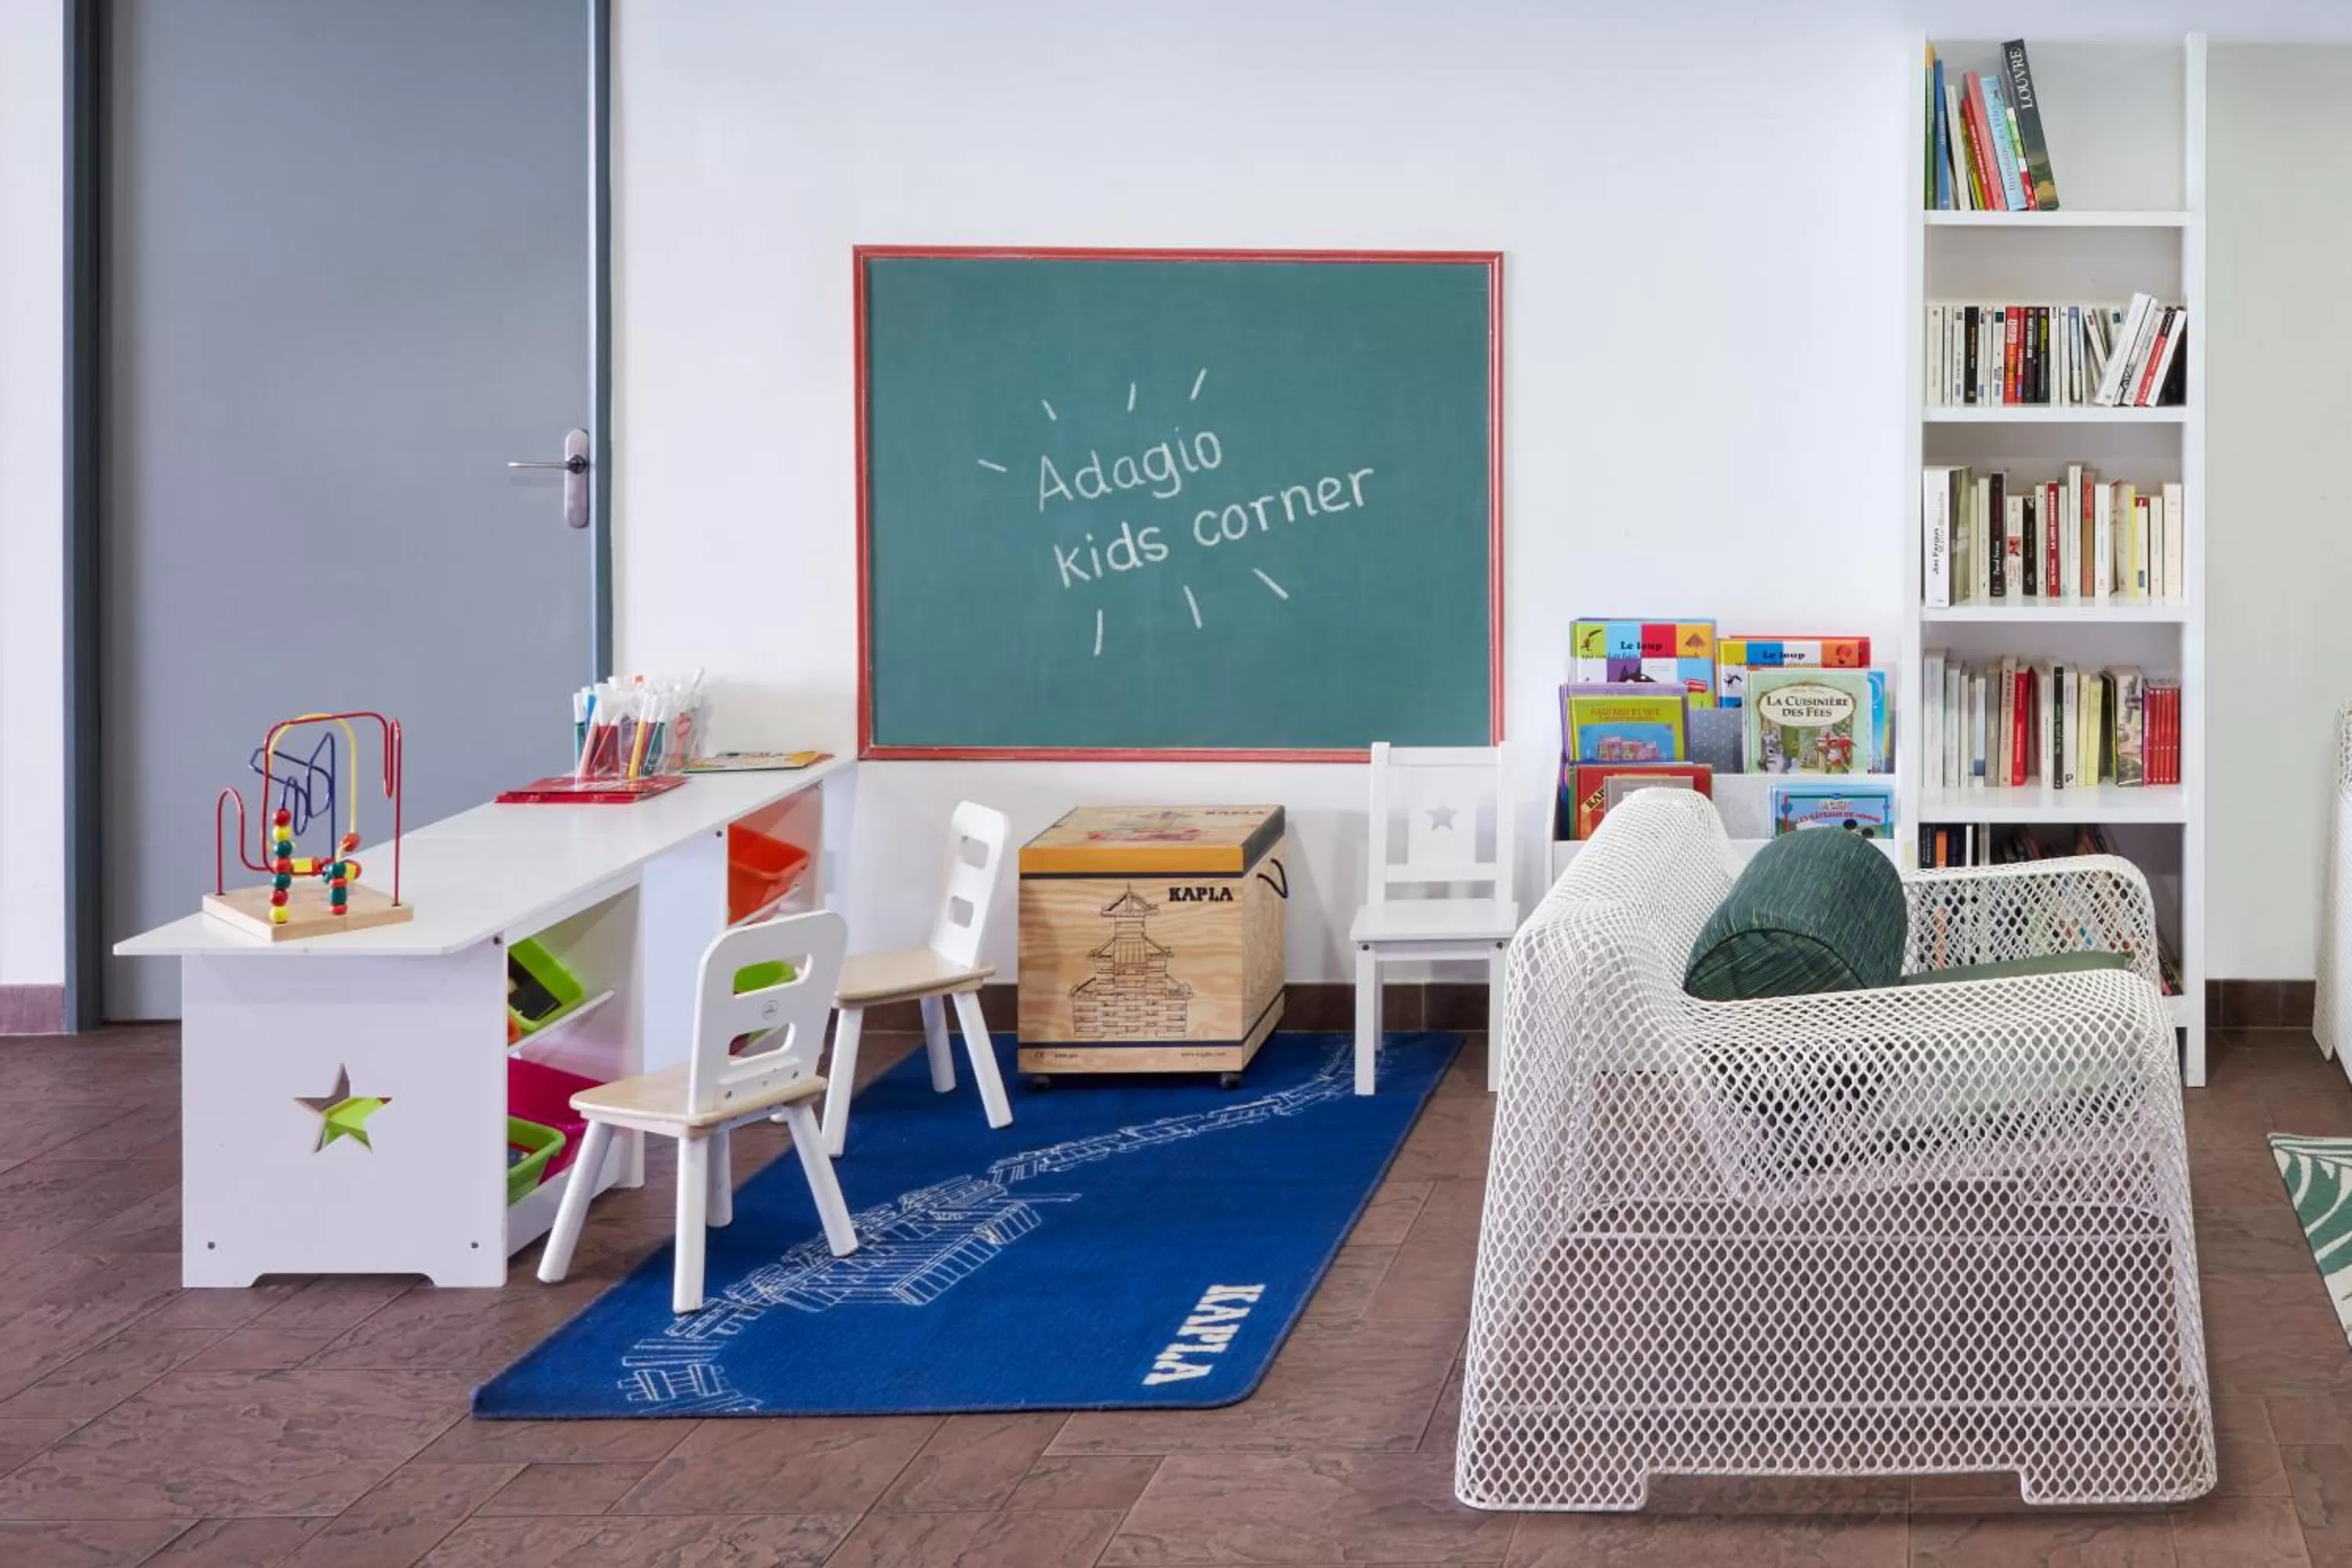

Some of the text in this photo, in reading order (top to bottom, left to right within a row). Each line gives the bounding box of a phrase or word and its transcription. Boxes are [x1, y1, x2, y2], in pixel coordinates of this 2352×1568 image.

[2009, 47, 2033, 109] LOUVRE
[1039, 426, 1222, 512] Adagio
[1054, 467, 1374, 589] kids corner
[1621, 641, 1663, 652] Le loup
[1780, 652, 1806, 660] loup
[1782, 708, 1803, 717] DES
[1168, 887, 1234, 902] KAPLA
[1142, 1283, 1268, 1386] KAPLA
